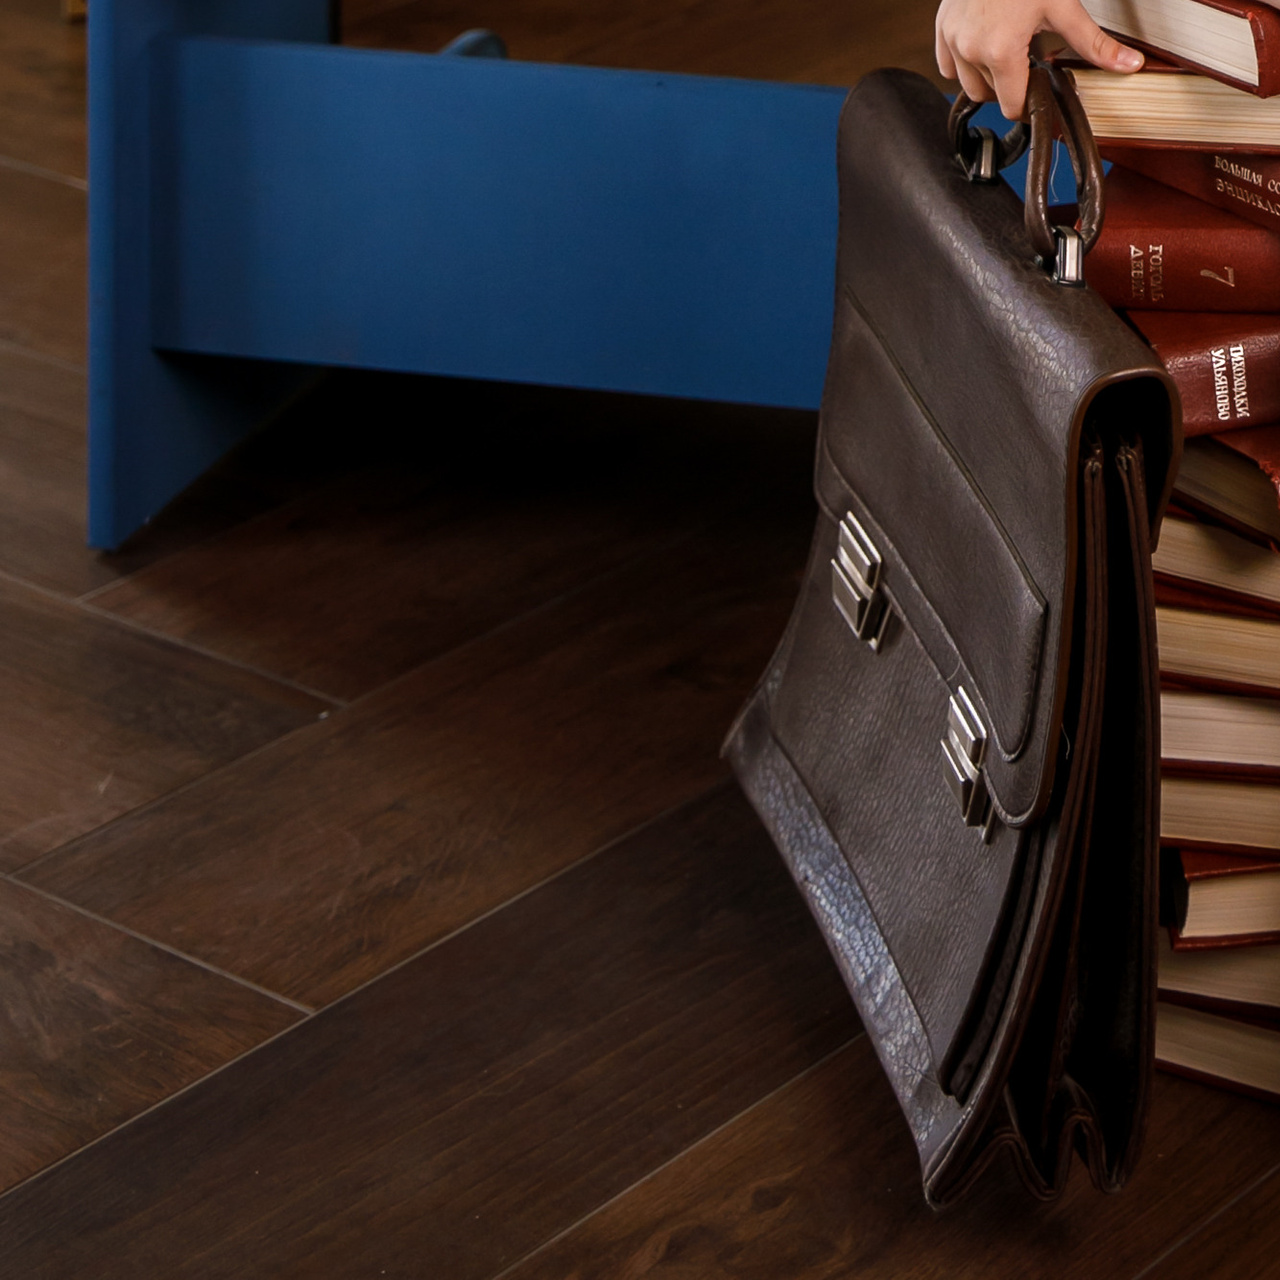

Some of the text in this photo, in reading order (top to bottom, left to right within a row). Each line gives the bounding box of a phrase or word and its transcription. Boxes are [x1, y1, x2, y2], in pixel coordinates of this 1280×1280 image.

[1214, 155, 1263, 187] БОЛЬШАЯ
[1200, 265, 1235, 288] 7
[1210, 348, 1231, 421] УЛЬЯНОВО
[1229, 343, 1251, 419] ТИХОХОДКИ
